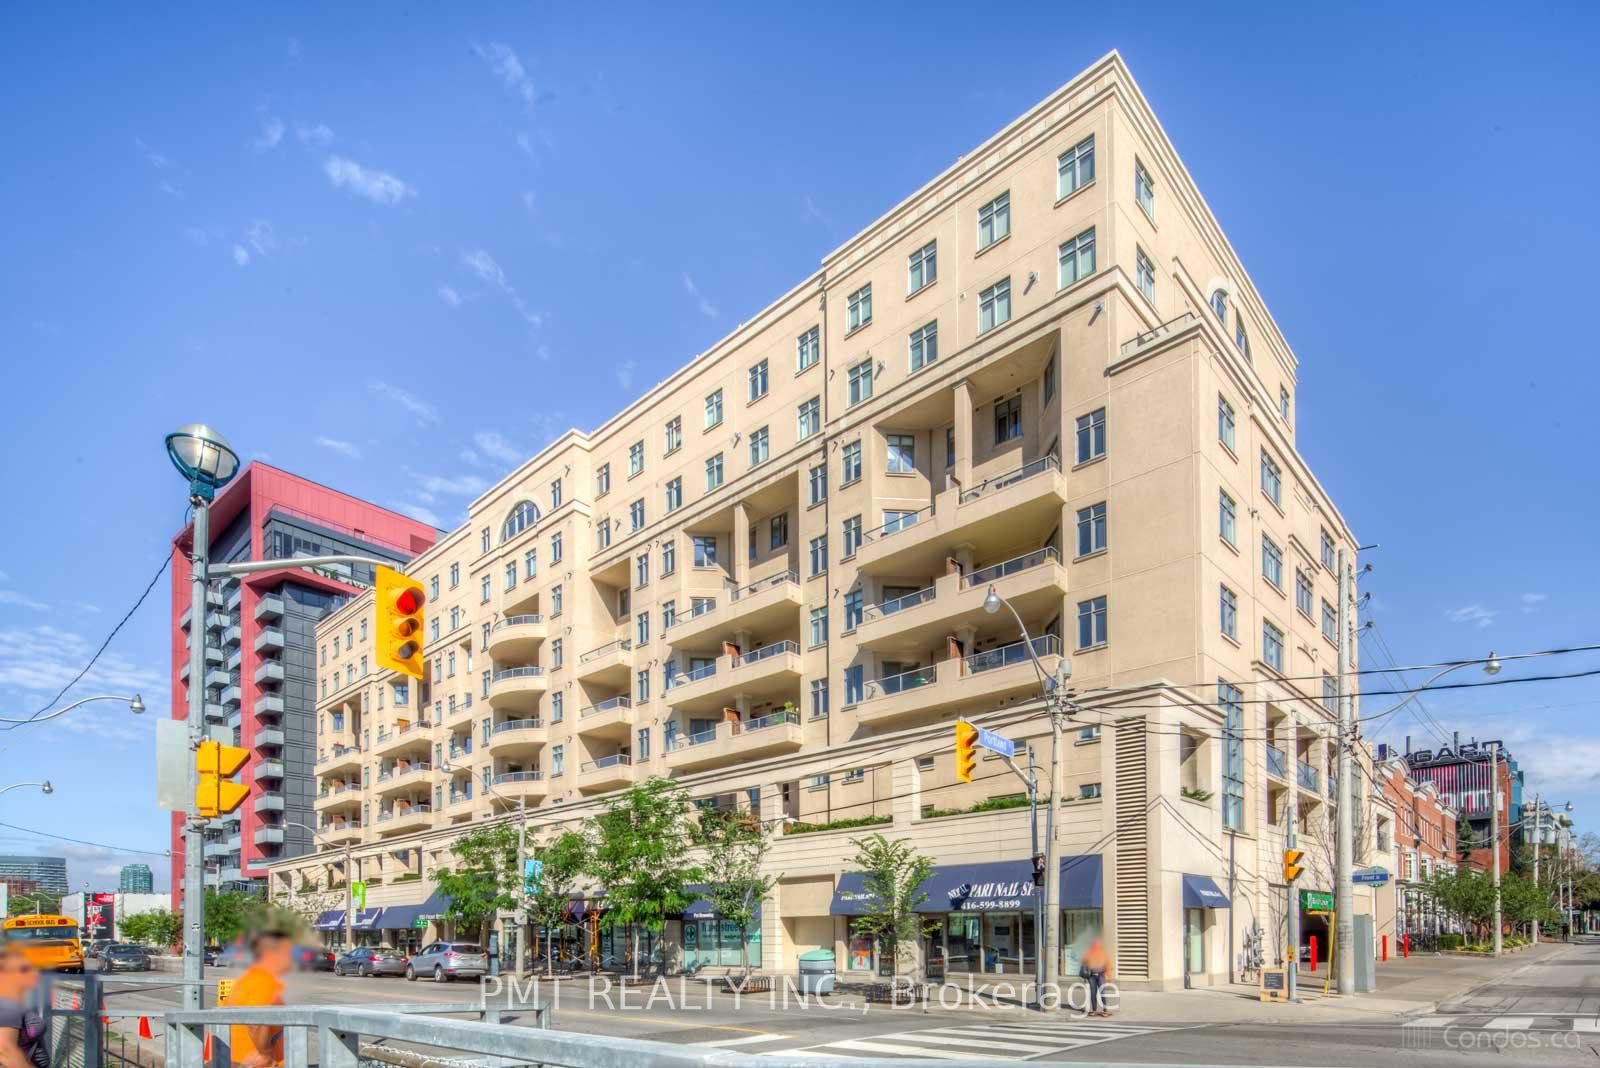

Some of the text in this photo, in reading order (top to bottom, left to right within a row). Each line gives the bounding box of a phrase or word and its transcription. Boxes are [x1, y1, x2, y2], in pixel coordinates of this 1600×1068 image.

[968, 883, 995, 897] PARI
[1020, 881, 1036, 896] SP
[960, 899, 1021, 910] 416-599-8899
